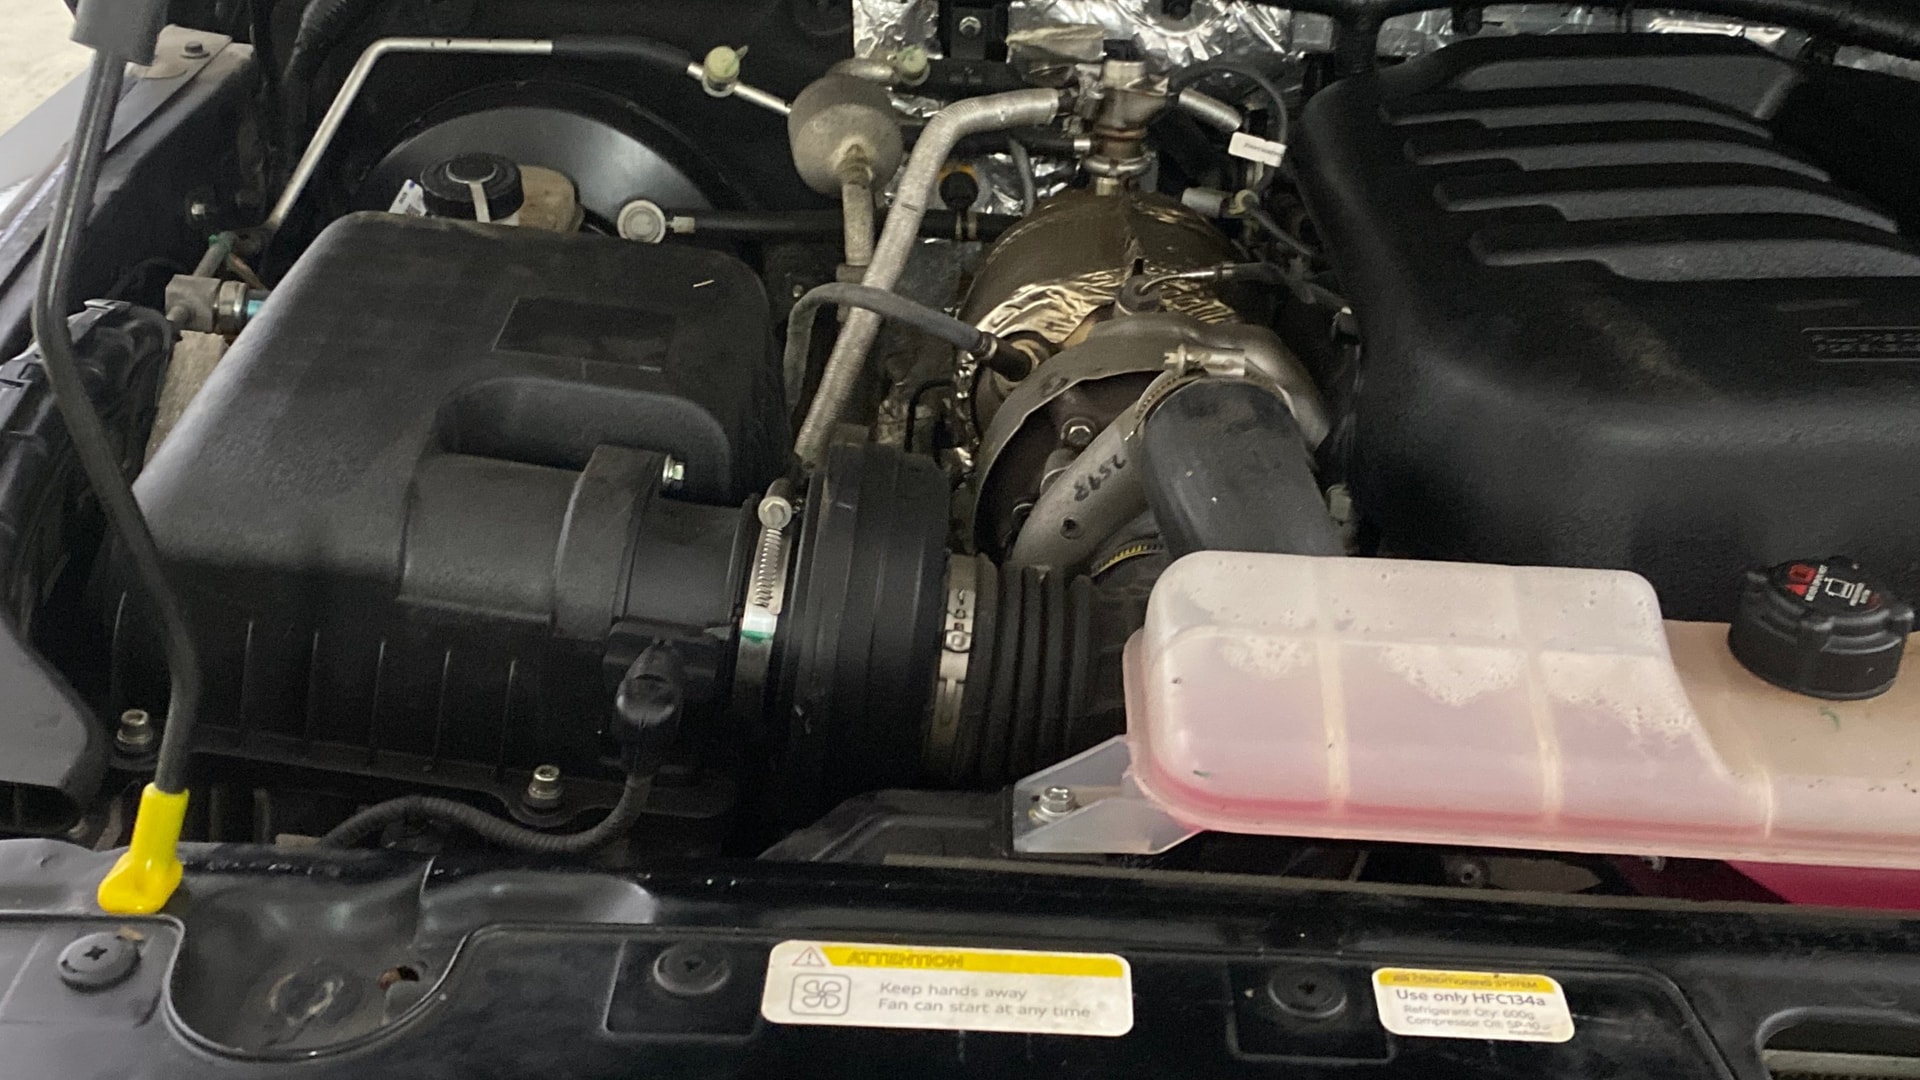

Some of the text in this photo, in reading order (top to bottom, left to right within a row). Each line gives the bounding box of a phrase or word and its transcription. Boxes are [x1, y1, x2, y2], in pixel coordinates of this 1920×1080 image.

[847, 950, 964, 967] ATTENTION
[880, 982, 1027, 1001] Keep hands away
[1396, 989, 1547, 1006] Use only HFC134a
[879, 998, 1091, 1019] Fan can start at any time
[1404, 1005, 1470, 1017] Refrigerant
[1503, 1009, 1535, 1020] 600g
[1406, 1016, 1479, 1028] Compressor
